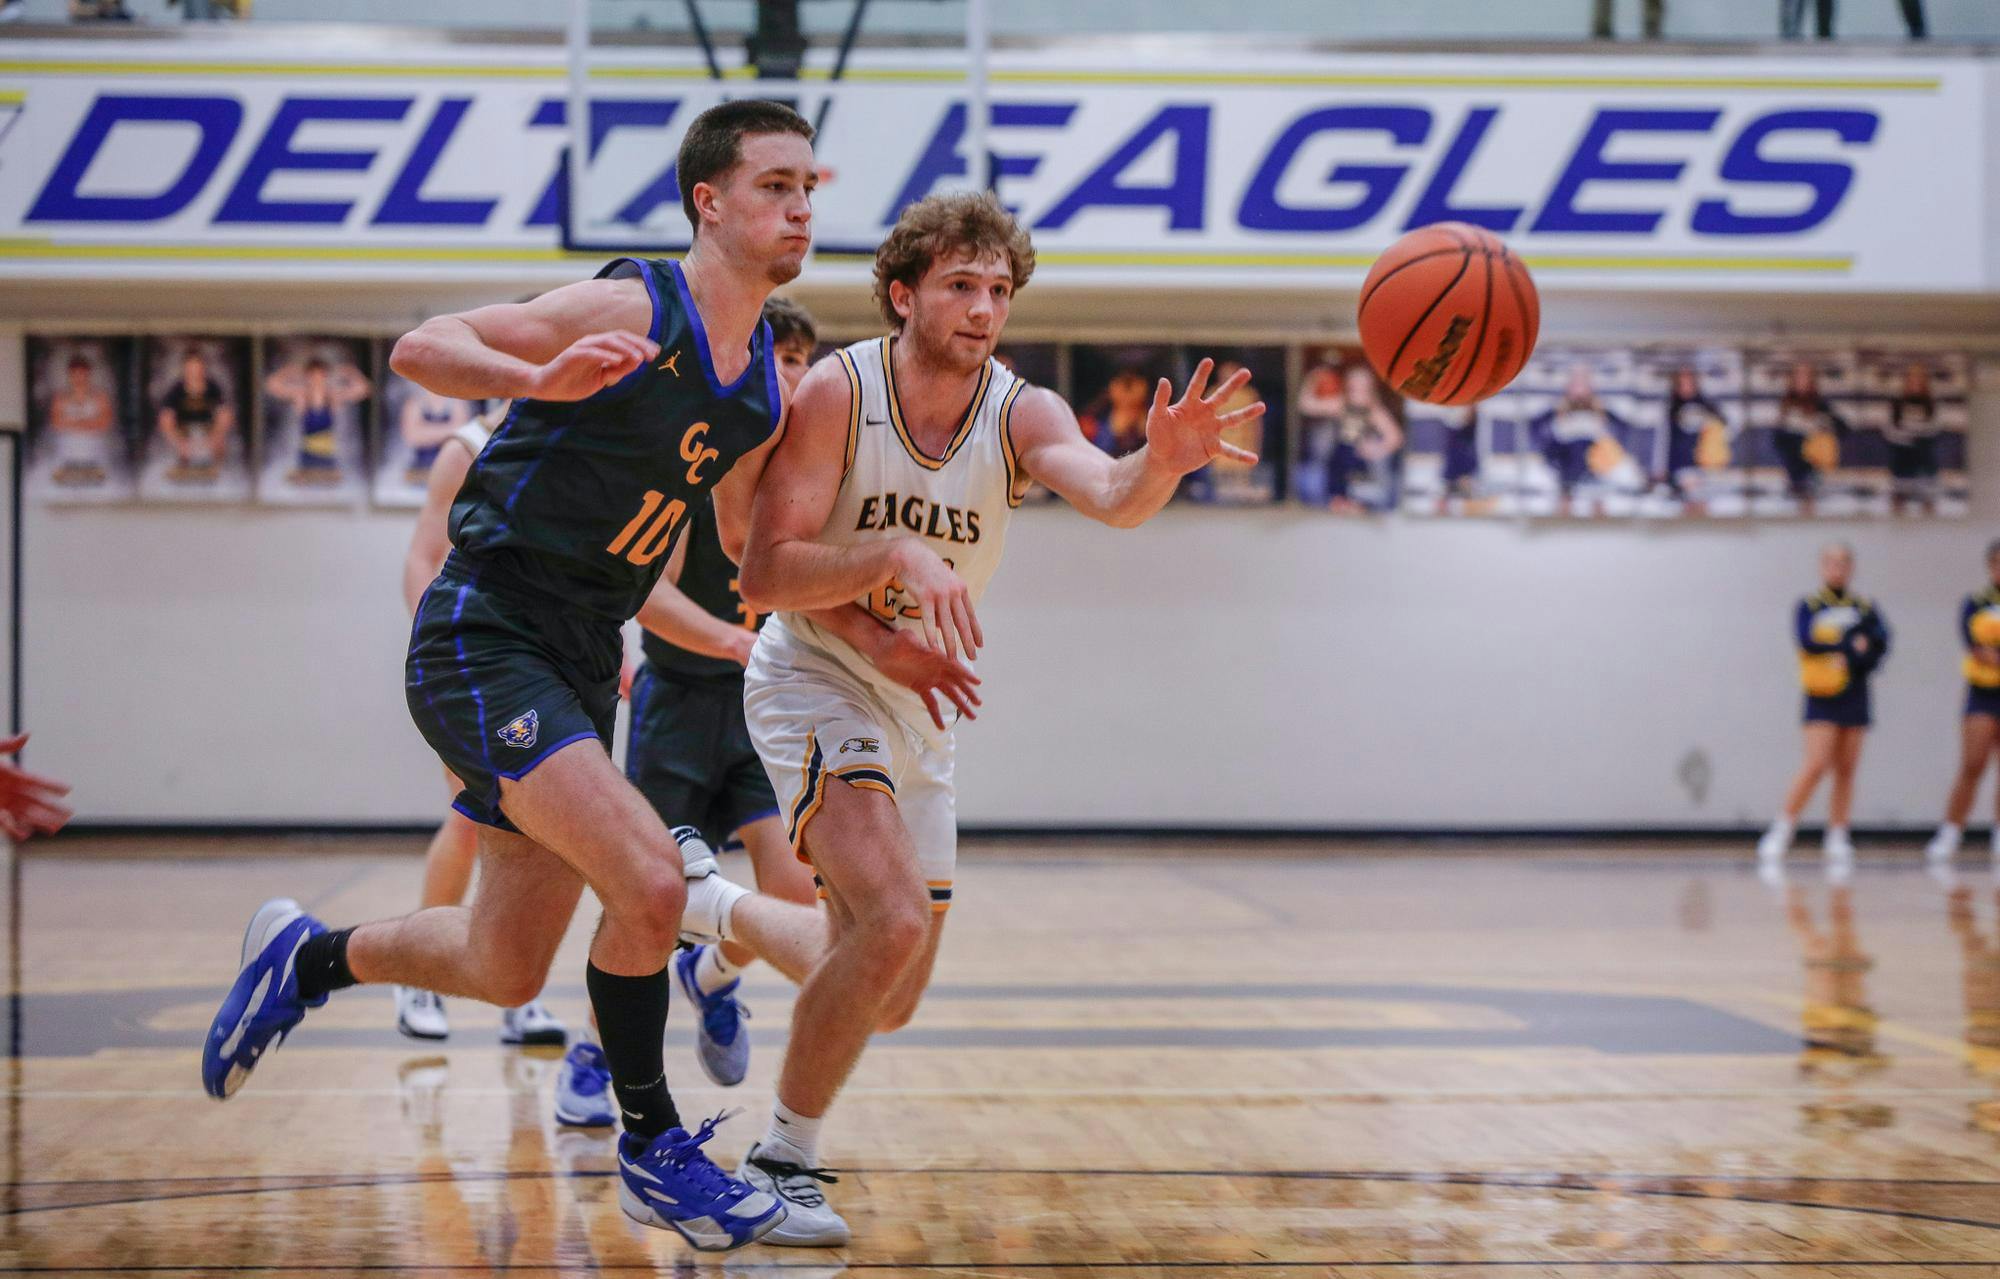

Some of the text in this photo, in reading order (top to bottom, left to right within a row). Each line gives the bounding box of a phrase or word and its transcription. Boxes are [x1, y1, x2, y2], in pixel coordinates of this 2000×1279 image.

[880, 103, 1882, 237] EAGLES
[606, 489, 688, 566] 10
[854, 492, 980, 544] EAGLES
